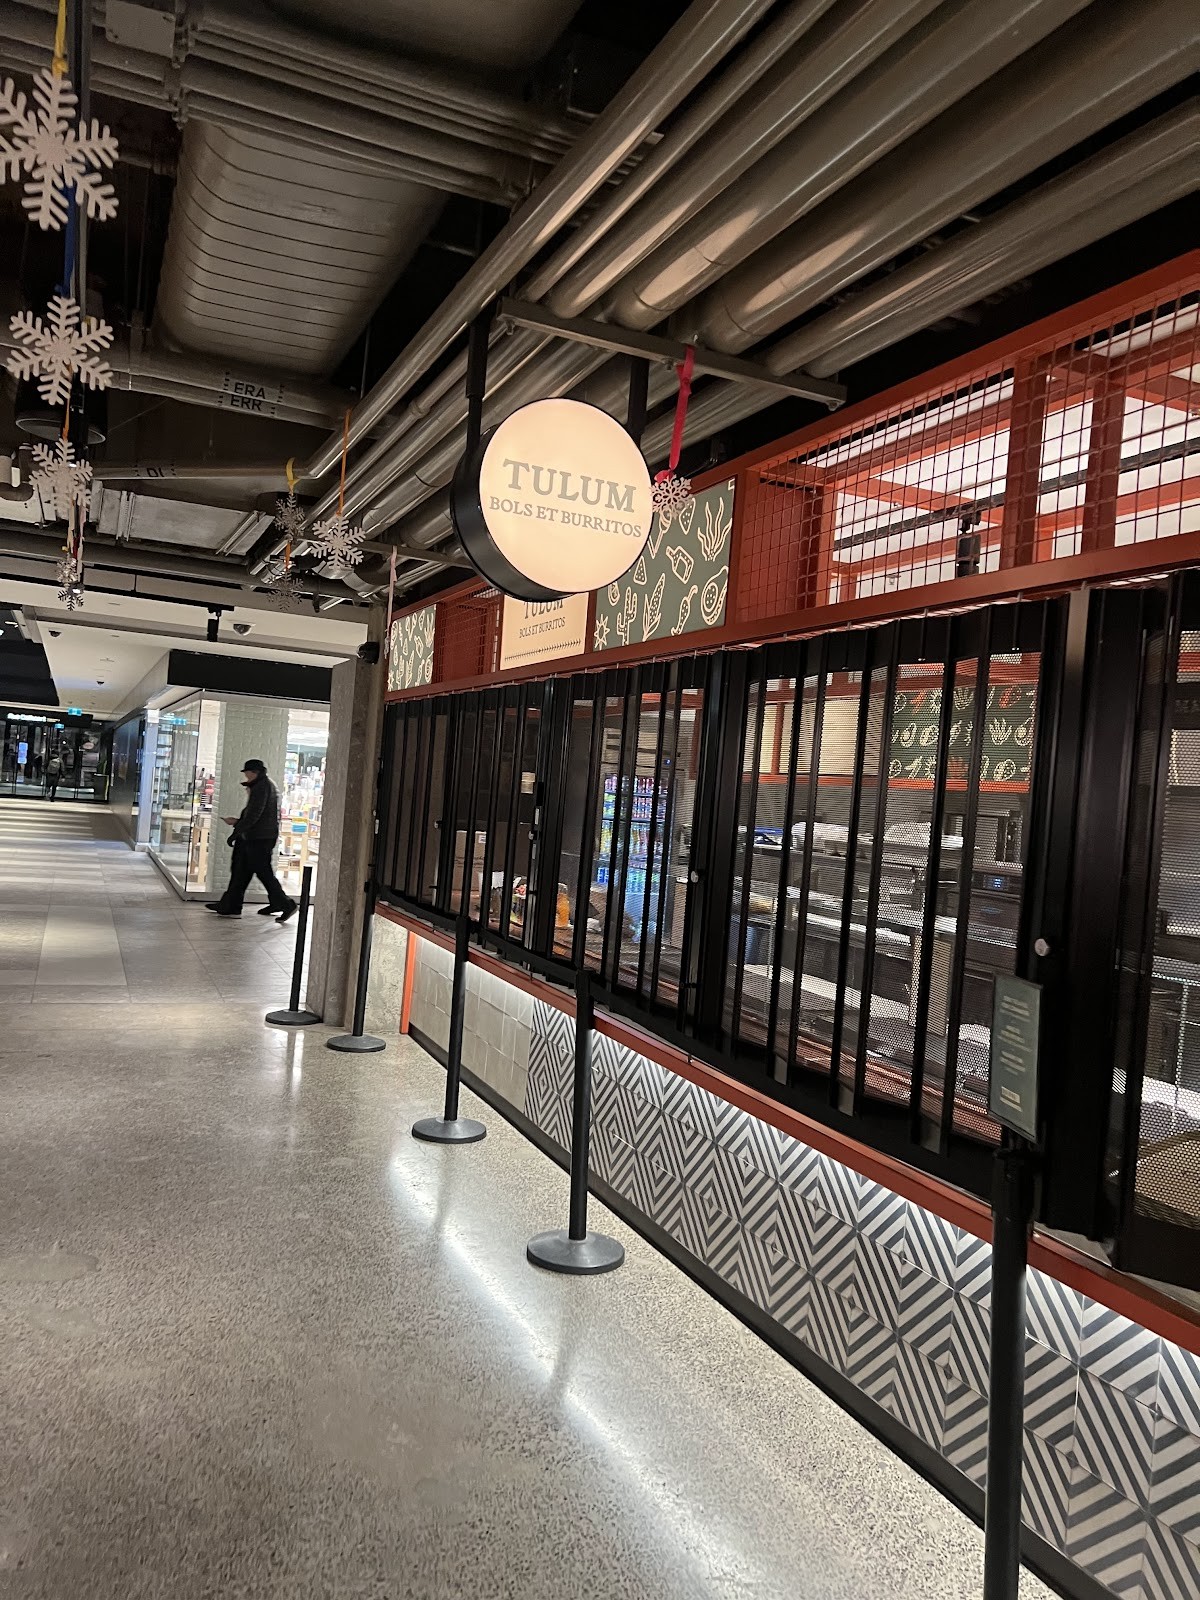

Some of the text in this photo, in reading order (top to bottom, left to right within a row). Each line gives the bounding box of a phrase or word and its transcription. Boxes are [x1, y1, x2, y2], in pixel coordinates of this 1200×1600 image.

[234, 382, 266, 399] ERA
[230, 394, 263, 411] ERR
[502, 458, 637, 513] TULUM
[489, 496, 642, 538] BOLS ET BURRITOS
[519, 616, 566, 638] BOLS ET BURRITOS
